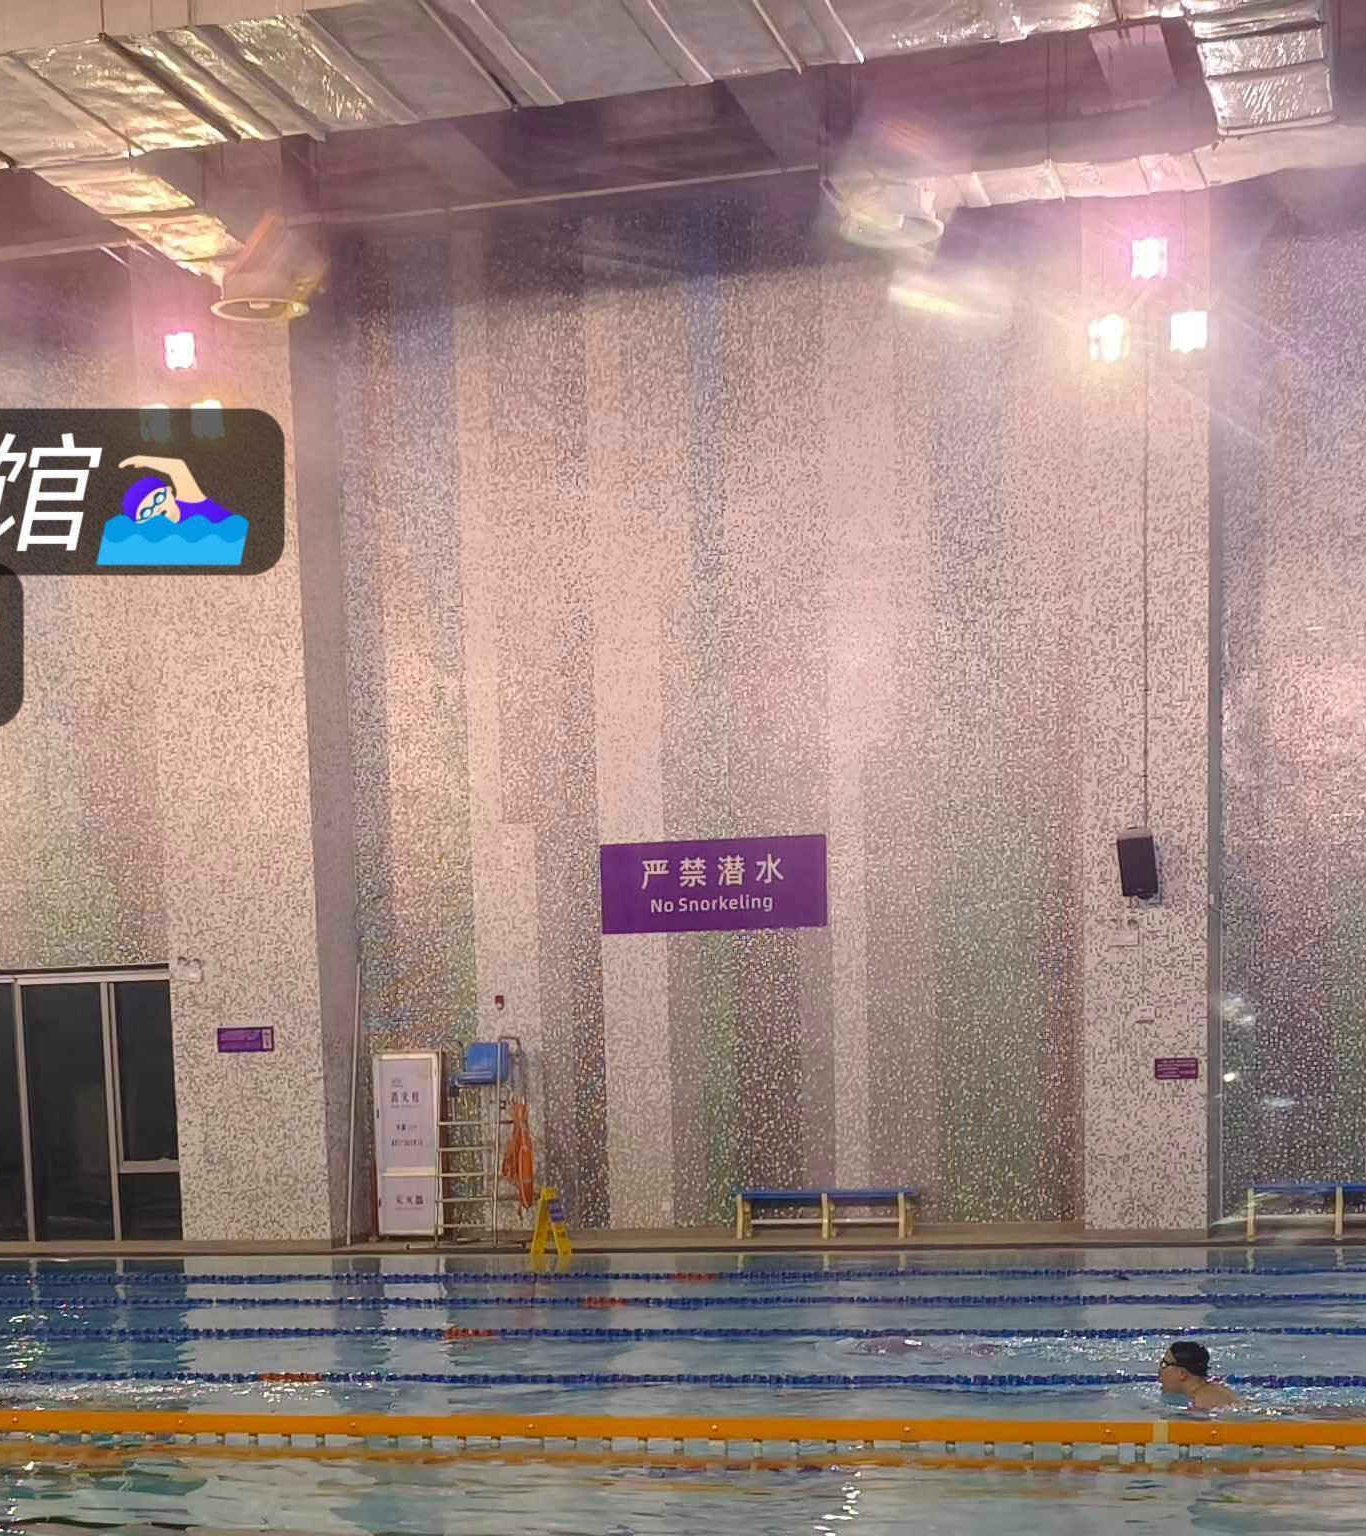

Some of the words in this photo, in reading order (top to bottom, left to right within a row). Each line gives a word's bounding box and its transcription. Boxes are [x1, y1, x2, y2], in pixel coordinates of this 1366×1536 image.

[640, 853, 784, 890] 严禁潜水
[650, 898, 674, 913] No
[678, 894, 773, 912] Snorkeling
